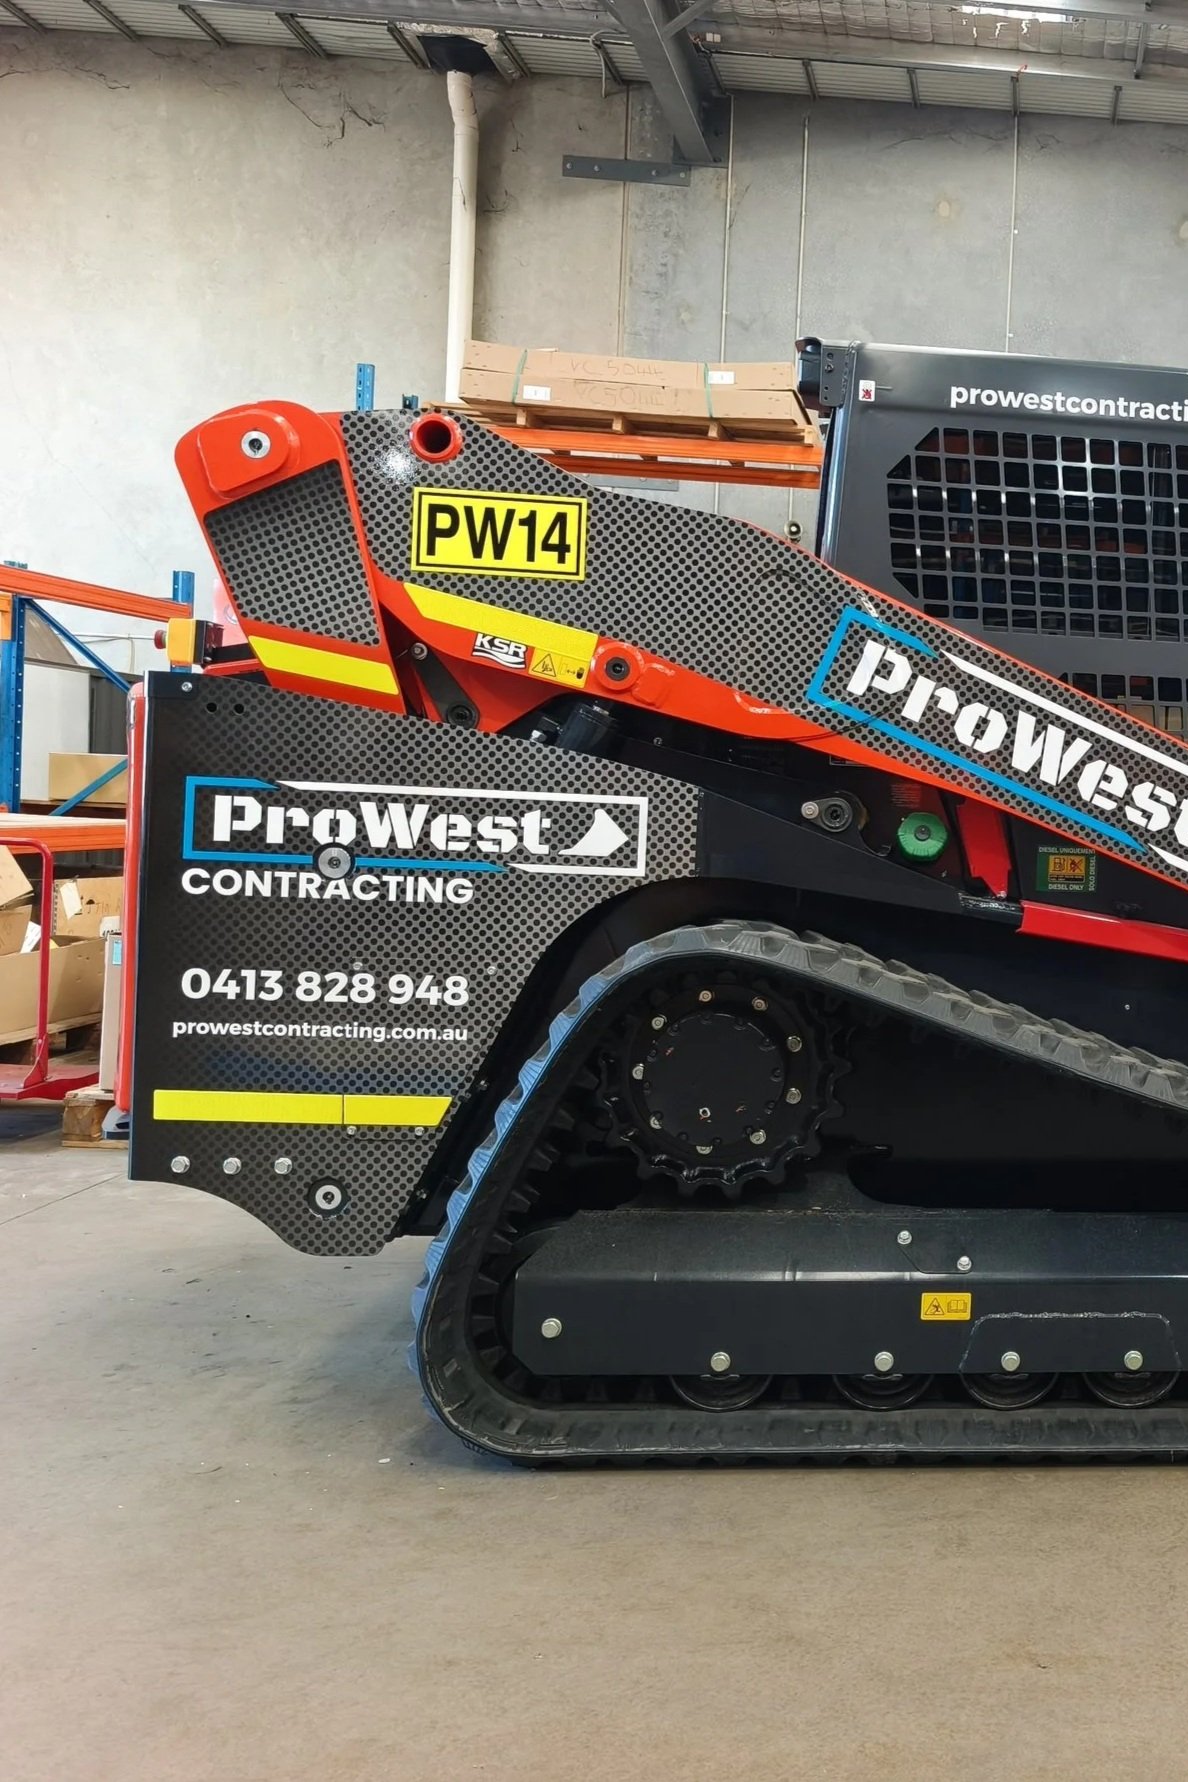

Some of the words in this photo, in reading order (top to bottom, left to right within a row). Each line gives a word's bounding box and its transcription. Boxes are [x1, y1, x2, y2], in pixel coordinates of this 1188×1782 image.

[426, 503, 571, 564] PW14
[476, 633, 527, 658] KSR
[213, 795, 551, 855] ProWest
[181, 868, 474, 904] CONTRACTING
[181, 968, 283, 1001] 0413
[295, 970, 376, 1004] 828
[388, 973, 470, 1006] 948
[172, 1019, 468, 1042] prowestcontracting.com.au
